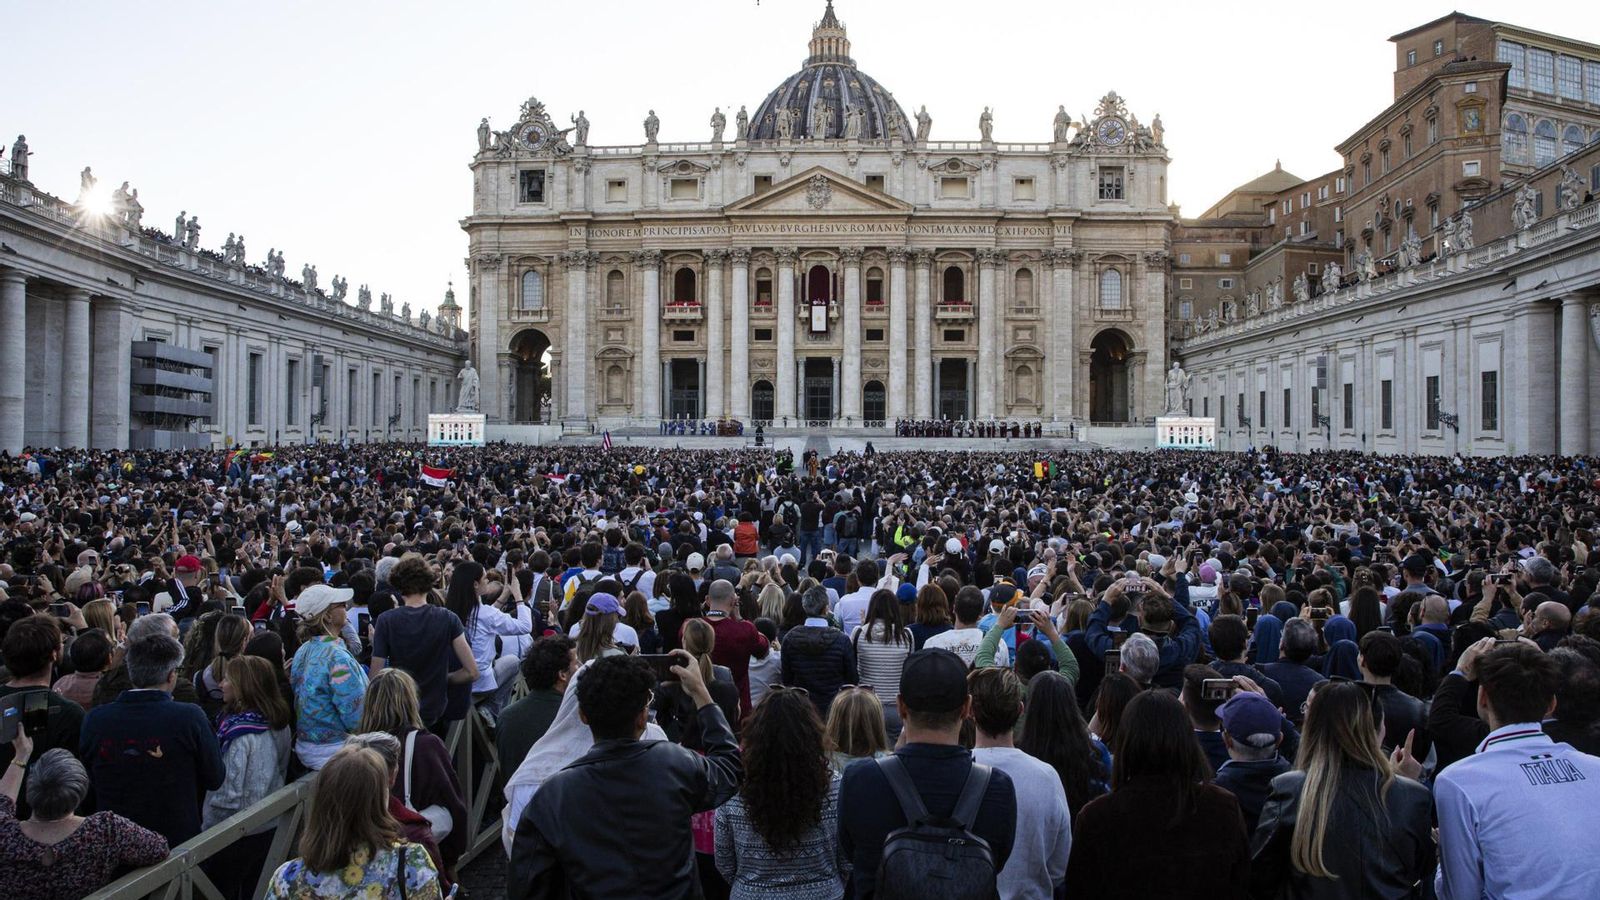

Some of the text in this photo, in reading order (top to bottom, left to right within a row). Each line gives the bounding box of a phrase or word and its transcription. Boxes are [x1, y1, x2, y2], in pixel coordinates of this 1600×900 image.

[570, 228, 582, 236] IN
[588, 229, 641, 237] HONOREM
[643, 226, 698, 235] PRINCIPIS
[733, 224, 770, 233] PAVLVS
[780, 224, 848, 233] BVRGHESIVS
[850, 224, 906, 232] ROMANVS
[1056, 225, 1071, 234] VII
[1519, 759, 1586, 786] ITALIA
